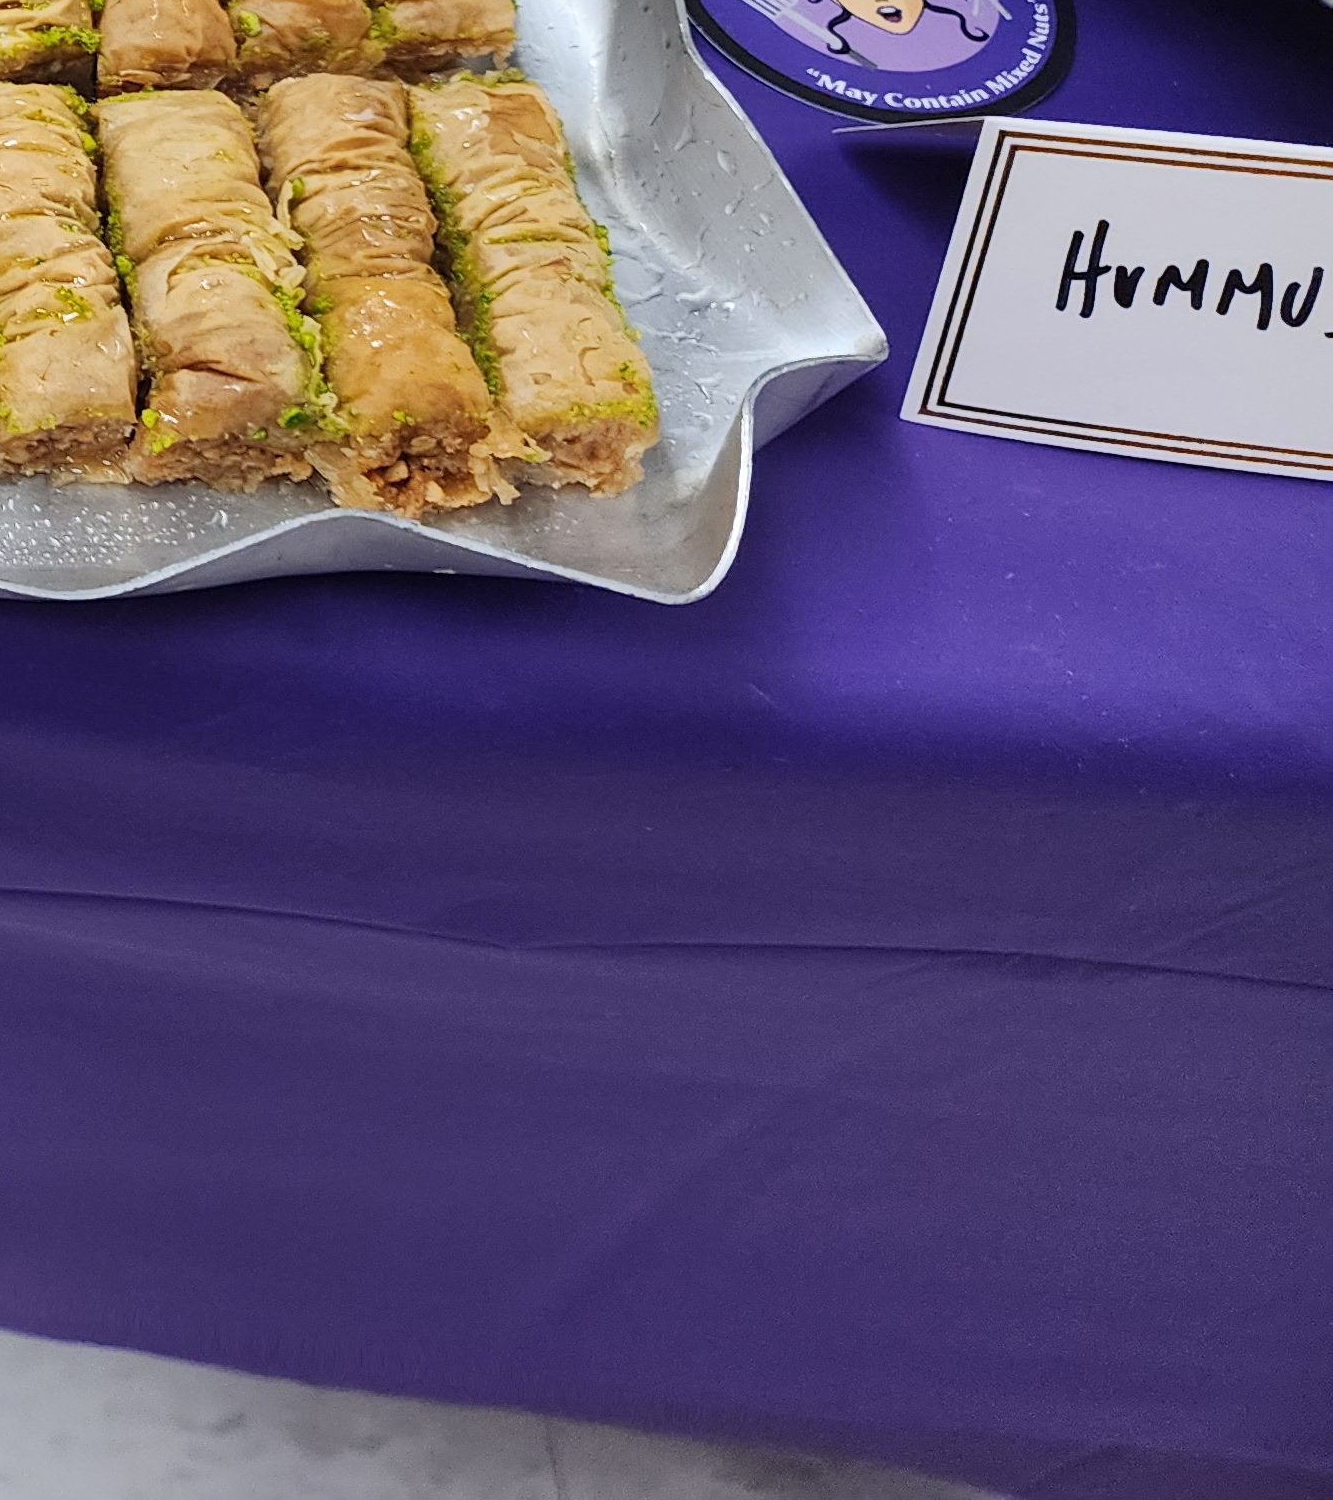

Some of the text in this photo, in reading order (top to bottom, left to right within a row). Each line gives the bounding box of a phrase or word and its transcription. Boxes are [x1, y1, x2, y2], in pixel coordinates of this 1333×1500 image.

[882, 87, 990, 111] Contain
[985, 48, 1042, 94] Mixed
[1055, 219, 1333, 339] HUMMU
